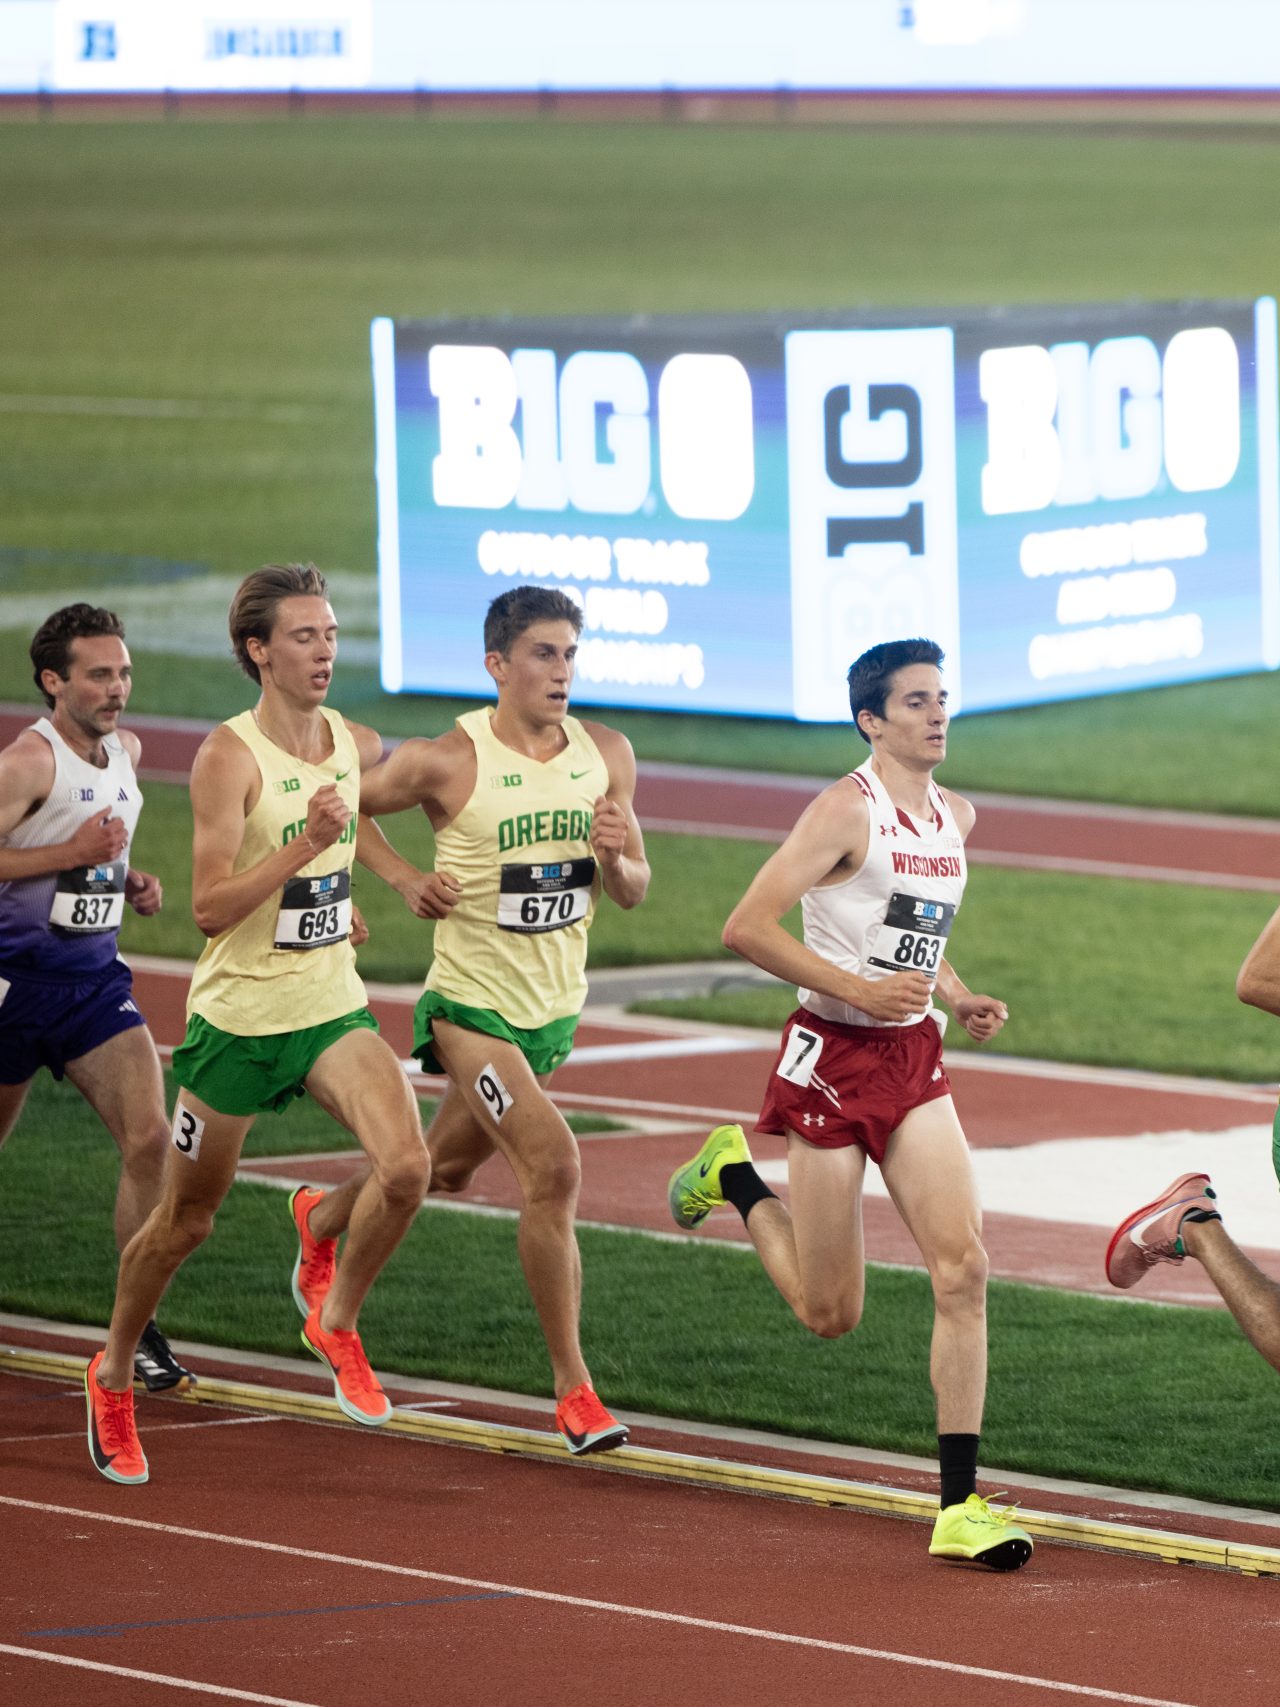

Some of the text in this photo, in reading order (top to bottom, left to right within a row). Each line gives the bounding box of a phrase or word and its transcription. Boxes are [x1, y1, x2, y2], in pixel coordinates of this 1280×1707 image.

[498, 809, 593, 853] OREGON
[891, 852, 961, 878] WISCONSIN
[71, 898, 114, 925] 837
[298, 906, 339, 941] 693
[521, 893, 575, 924] 670
[894, 933, 941, 969] 863
[785, 1030, 817, 1077] 7
[480, 1074, 504, 1117] 9
[176, 1110, 197, 1153] 3
